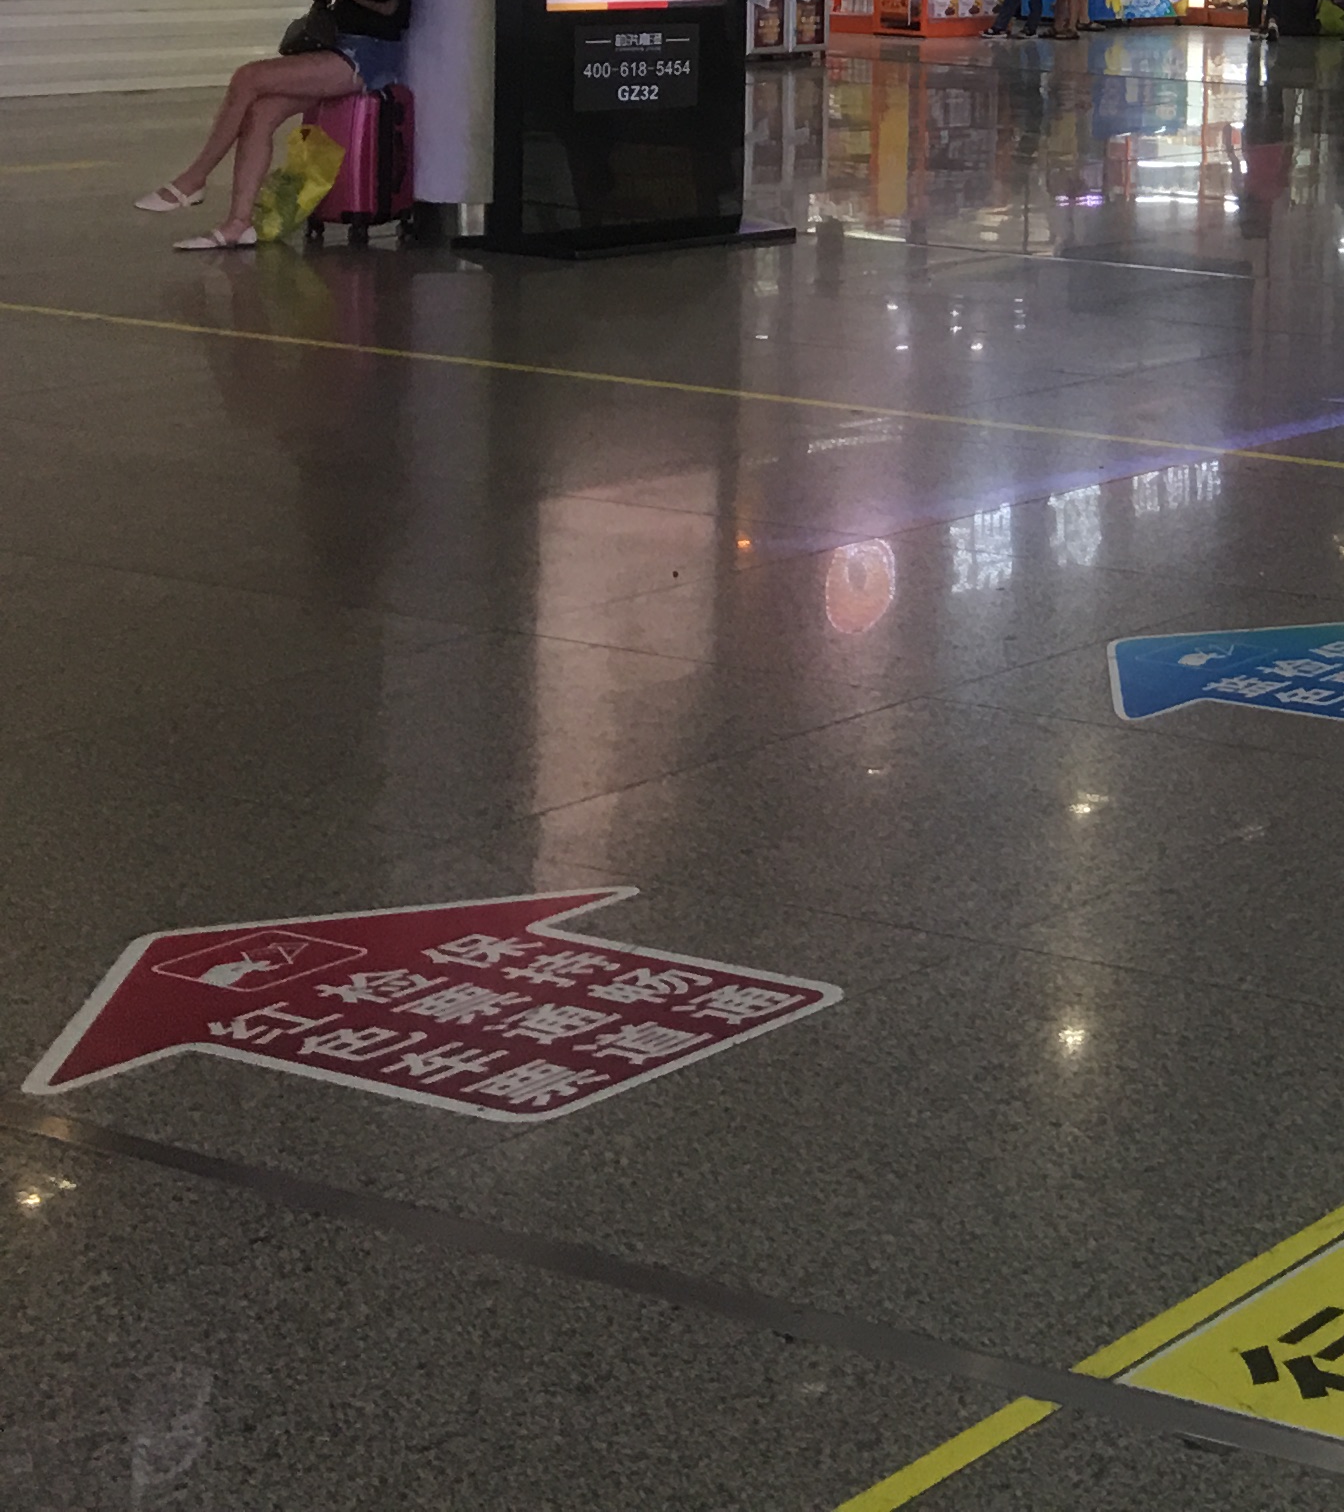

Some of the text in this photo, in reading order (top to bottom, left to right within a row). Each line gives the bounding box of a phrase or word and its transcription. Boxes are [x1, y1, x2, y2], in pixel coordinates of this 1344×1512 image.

[583, 60, 692, 79] 400-618-5454
[617, 84, 659, 101] GZ32
[313, 967, 716, 1067] 检票通道
[420, 931, 807, 1028] 保持畅通
[206, 1008, 609, 1108] 红色车票
